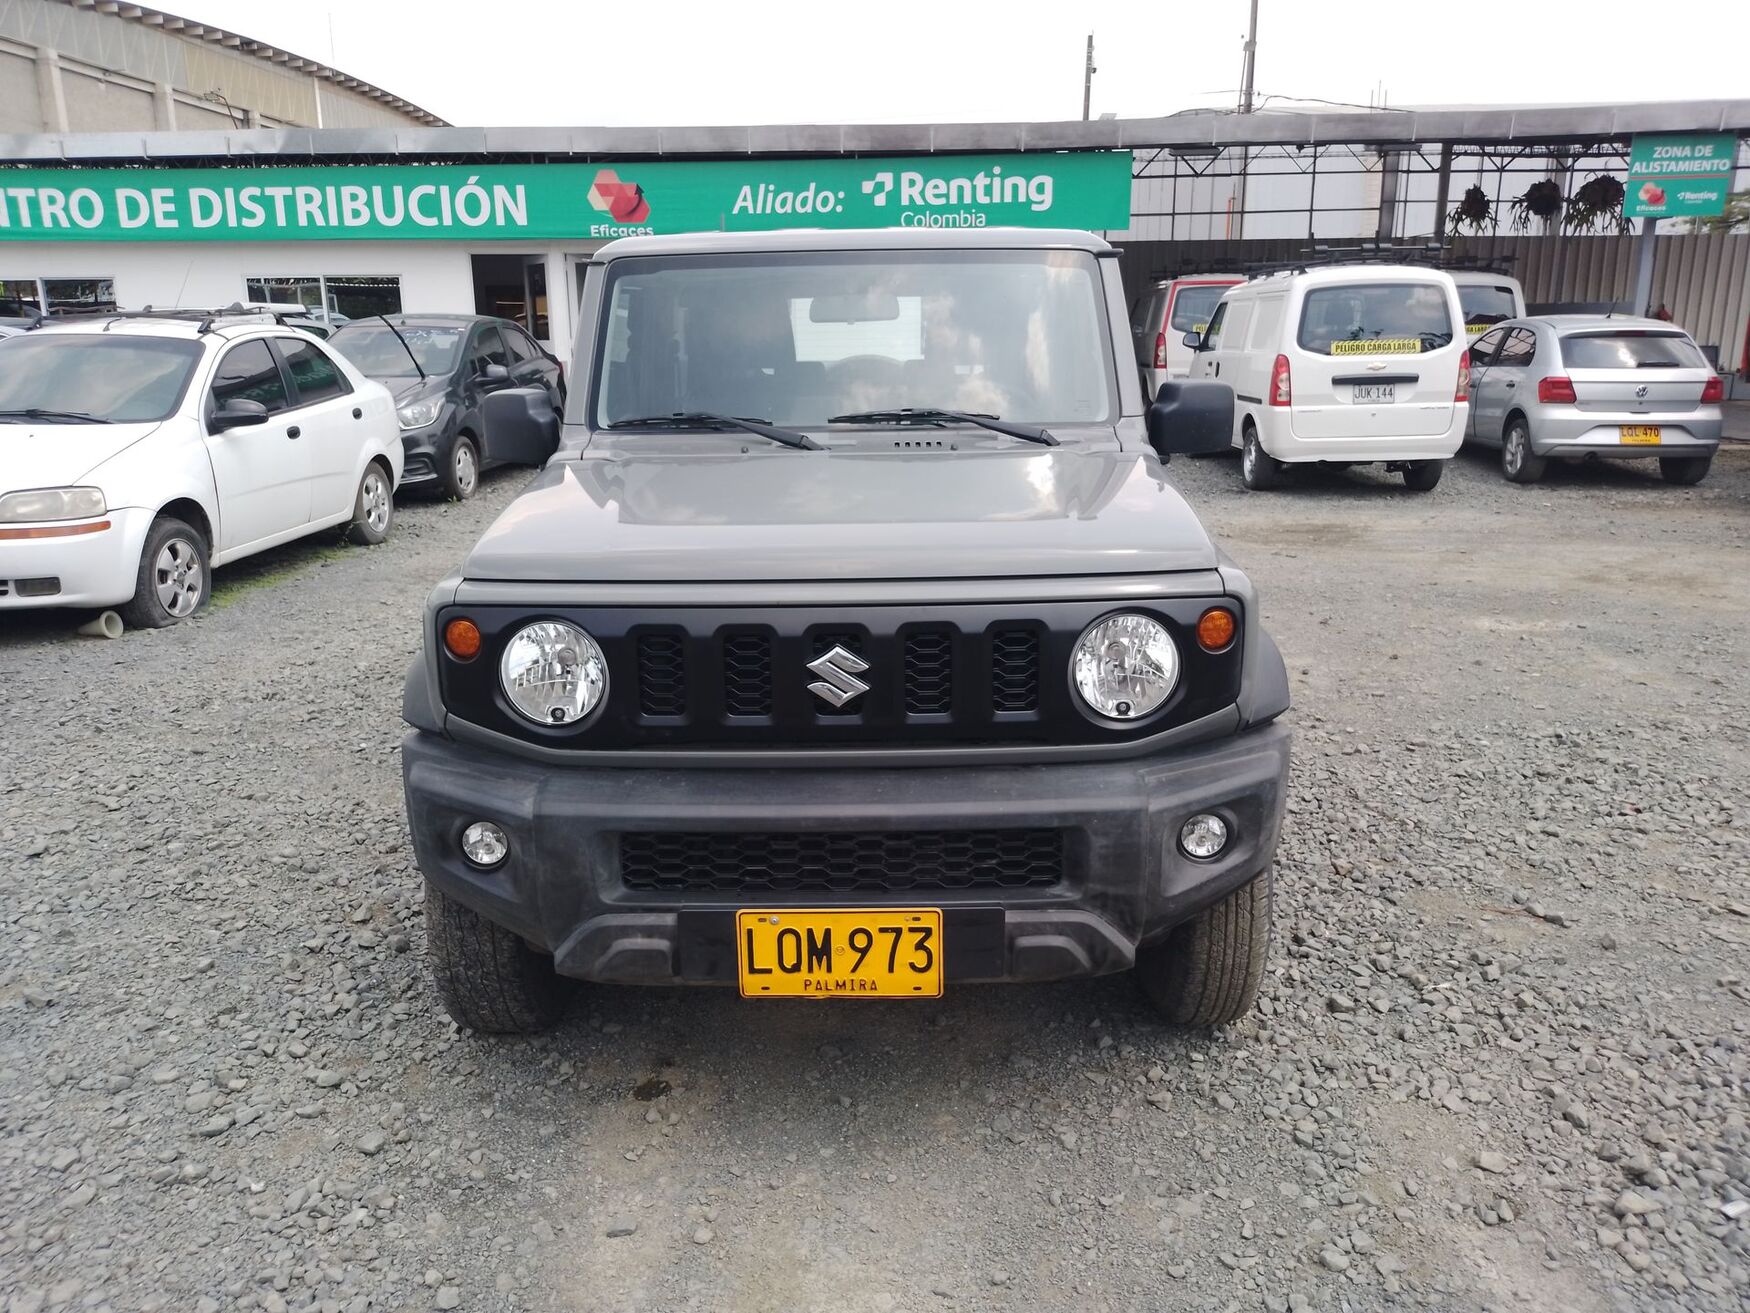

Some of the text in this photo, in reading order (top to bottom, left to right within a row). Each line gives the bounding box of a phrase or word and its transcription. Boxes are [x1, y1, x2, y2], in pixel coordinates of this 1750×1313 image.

[1653, 145, 1714, 158] ZONA DE
[1631, 159, 1730, 173] ALISTAMIENTO
[901, 166, 1054, 212] Renting
[115, 188, 180, 229] DE
[188, 175, 528, 229] DISTRIBUCIÓN
[732, 182, 845, 214] Aliado:
[1684, 191, 1718, 201] Renting
[901, 209, 986, 228] Colombia
[590, 225, 654, 237] Eficaces
[1335, 342, 1417, 352] PELIGRO CARGA LARGA
[1355, 387, 1393, 399] JUK 144
[1642, 427, 1659, 437] 470
[747, 927, 933, 974] LQM 973
[804, 979, 877, 991] PALMIRA
